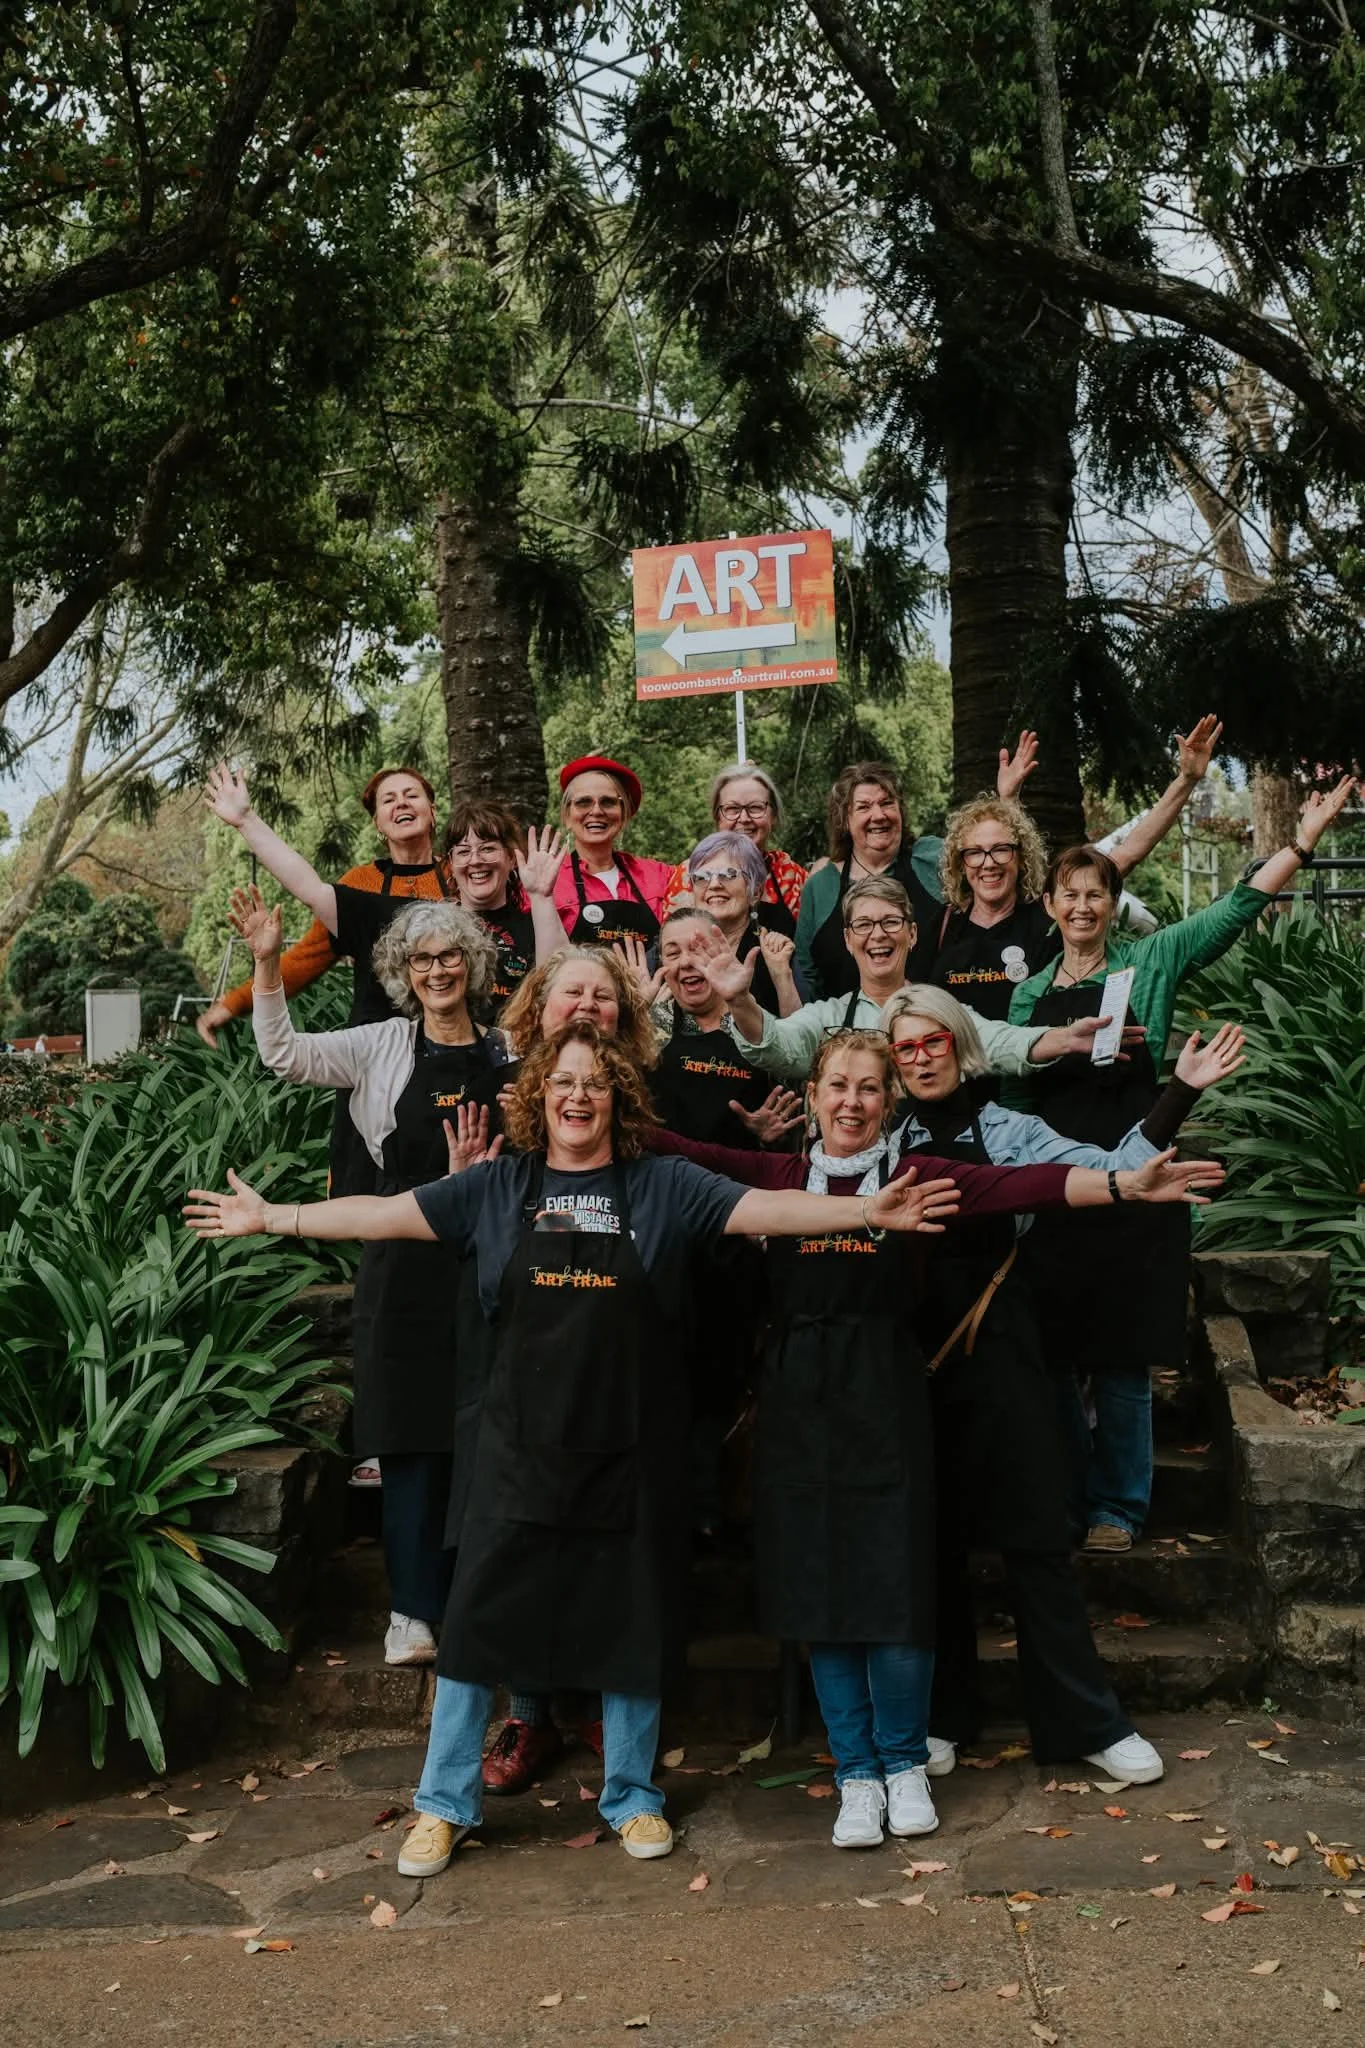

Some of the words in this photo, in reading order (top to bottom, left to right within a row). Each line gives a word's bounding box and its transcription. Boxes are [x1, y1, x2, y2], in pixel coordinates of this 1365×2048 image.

[658, 543, 807, 621] ART
[642, 667, 833, 693] toowoombastudioarttrail.com.au
[949, 974, 972, 985] ART
[975, 970, 1009, 983] TRAI
[685, 1061, 710, 1075] ART
[716, 1066, 752, 1080] TRAIL
[545, 1195, 575, 1213] EVER
[576, 1194, 612, 1213] MAKE
[574, 1211, 620, 1228] MISTAKES
[801, 1240, 825, 1255] ART
[833, 1239, 877, 1254] TRAIL
[535, 1274, 562, 1287] ART
[573, 1274, 617, 1288] TRAIL
